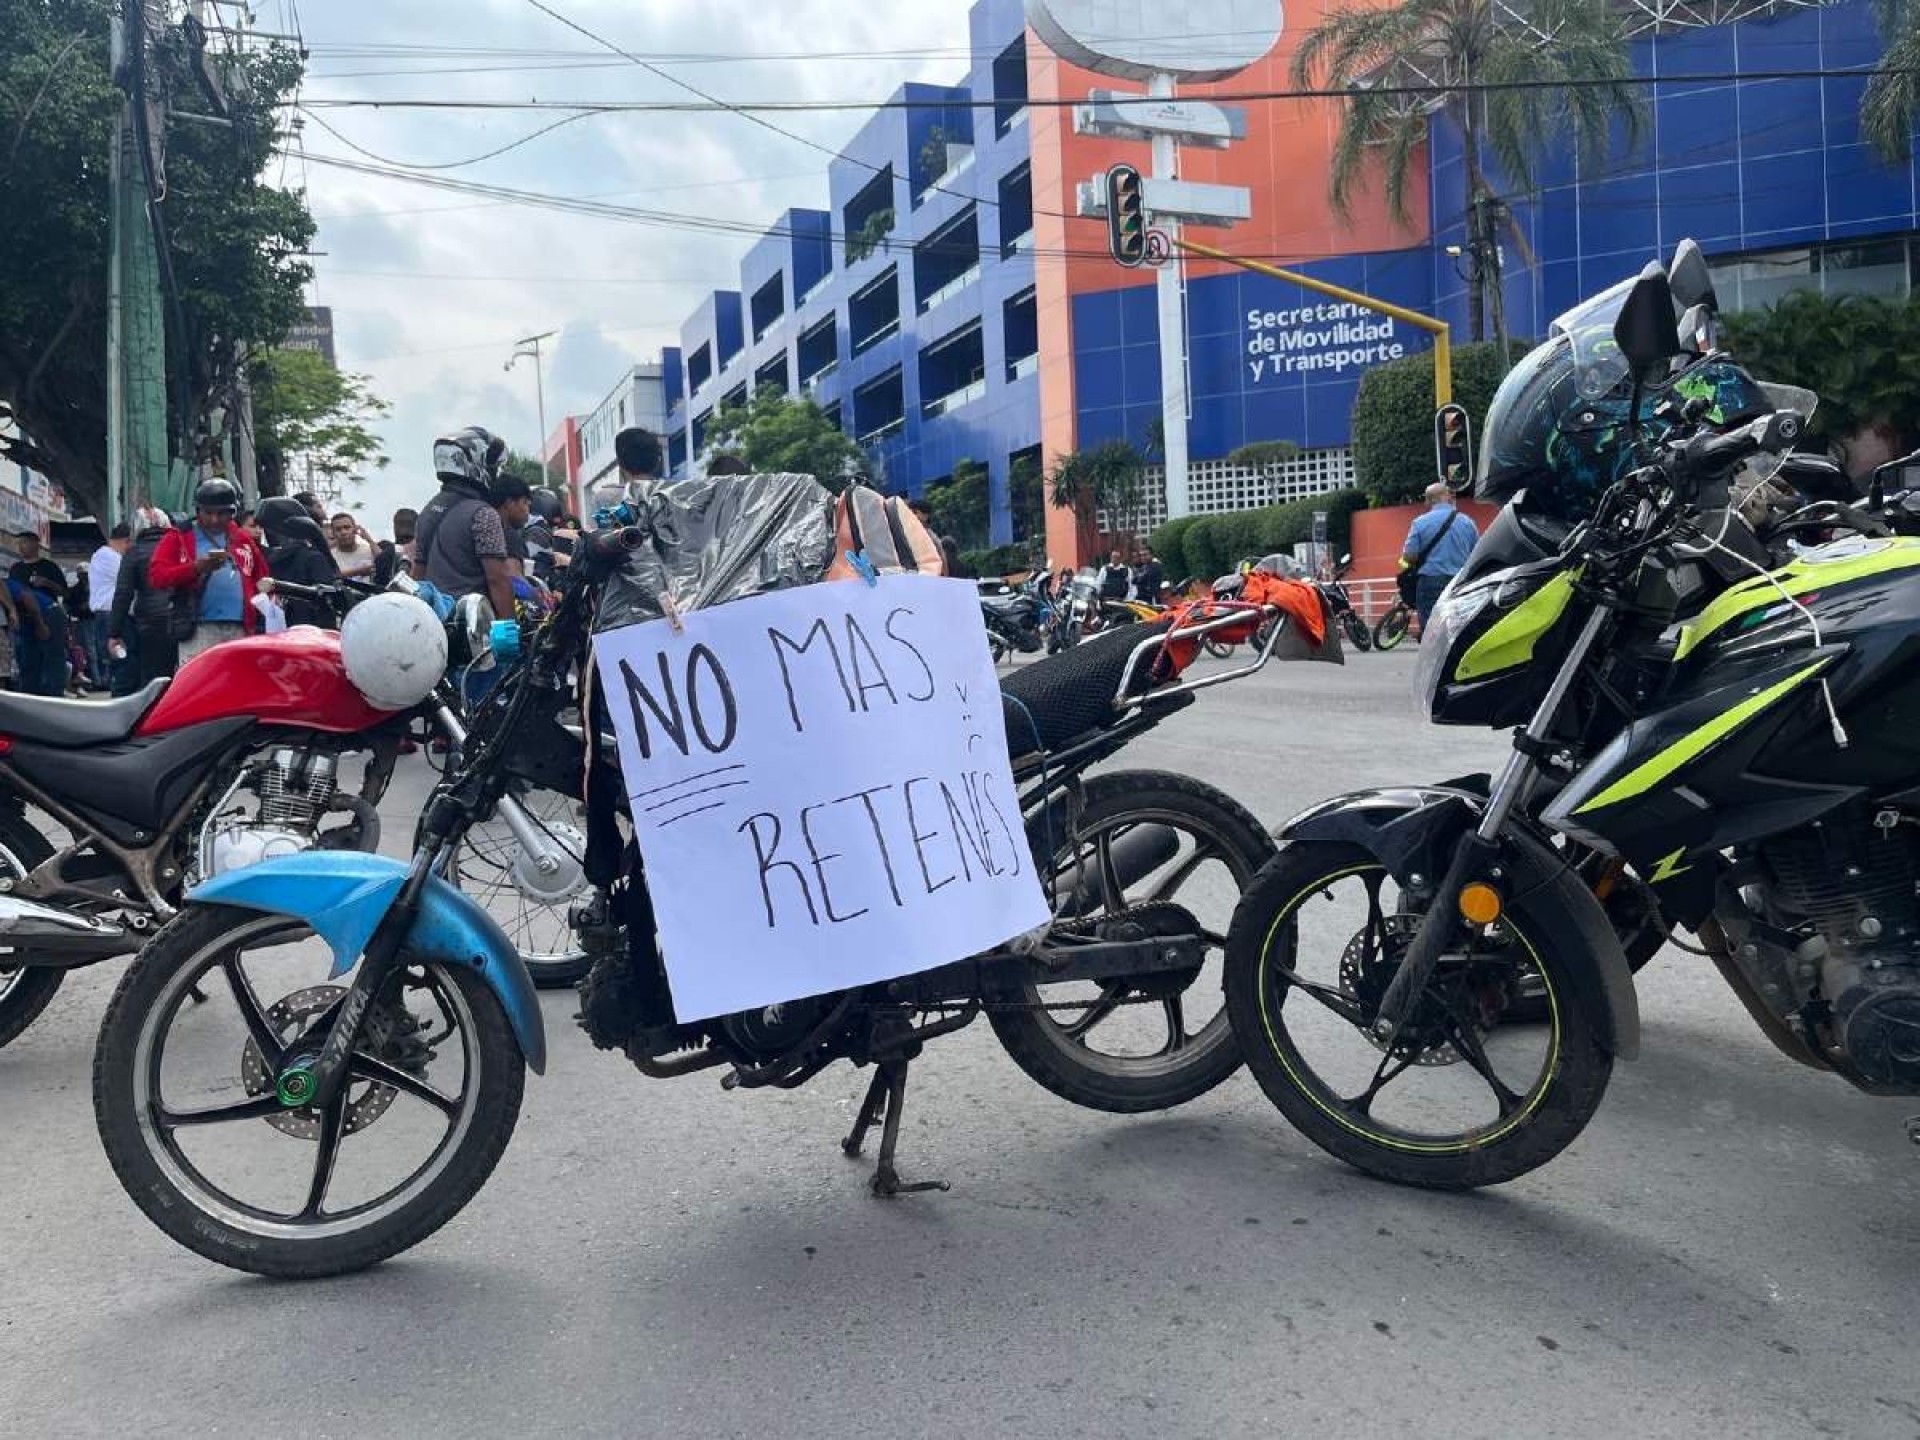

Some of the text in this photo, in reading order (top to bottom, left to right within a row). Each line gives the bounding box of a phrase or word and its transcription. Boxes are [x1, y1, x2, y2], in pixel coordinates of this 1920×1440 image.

[1249, 316, 1394, 354] de Movilidad
[1250, 343, 1404, 383] y Transporte
[619, 608, 935, 759] NO MAS
[737, 770, 1021, 928] RETENES
